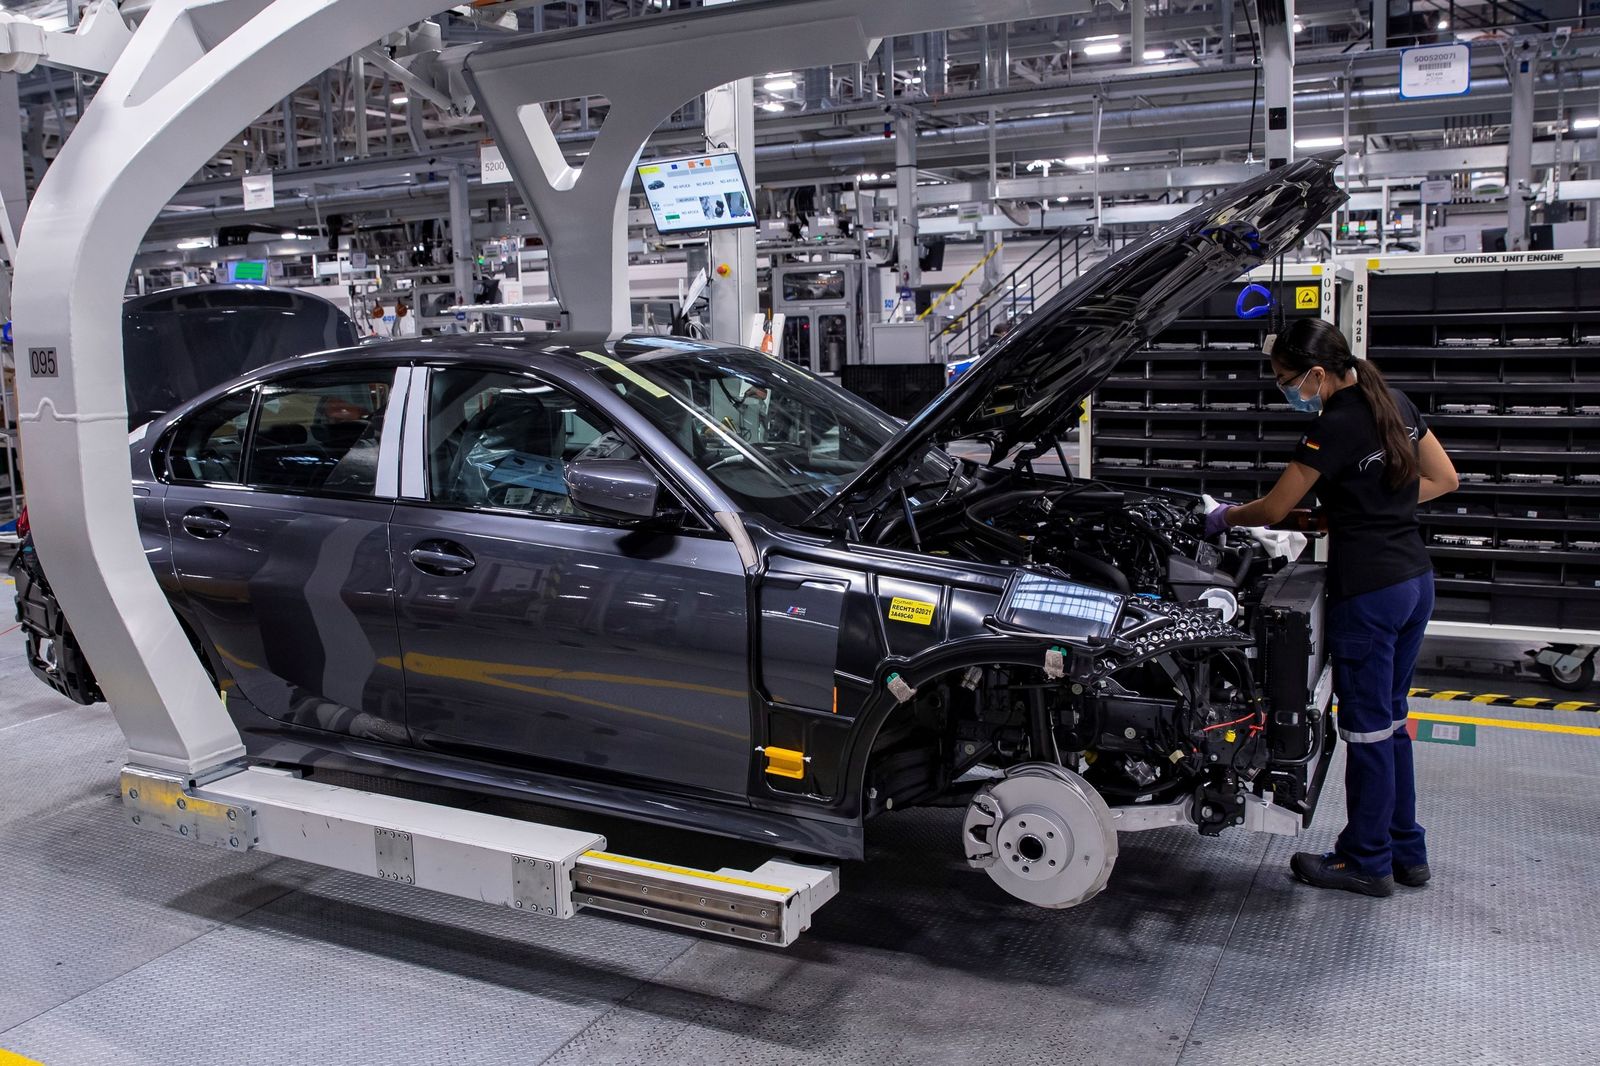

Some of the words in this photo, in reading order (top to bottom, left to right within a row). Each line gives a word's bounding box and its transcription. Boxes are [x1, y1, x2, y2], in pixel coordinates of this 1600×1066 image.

[1453, 255, 1499, 264] CONTROL
[1502, 254, 1525, 263] UNIT
[1526, 253, 1564, 262] ENGINE
[1323, 278, 1331, 315] 004
[1356, 284, 1364, 312] SET
[31, 350, 55, 375] 095
[891, 604, 915, 613] RECHTS
